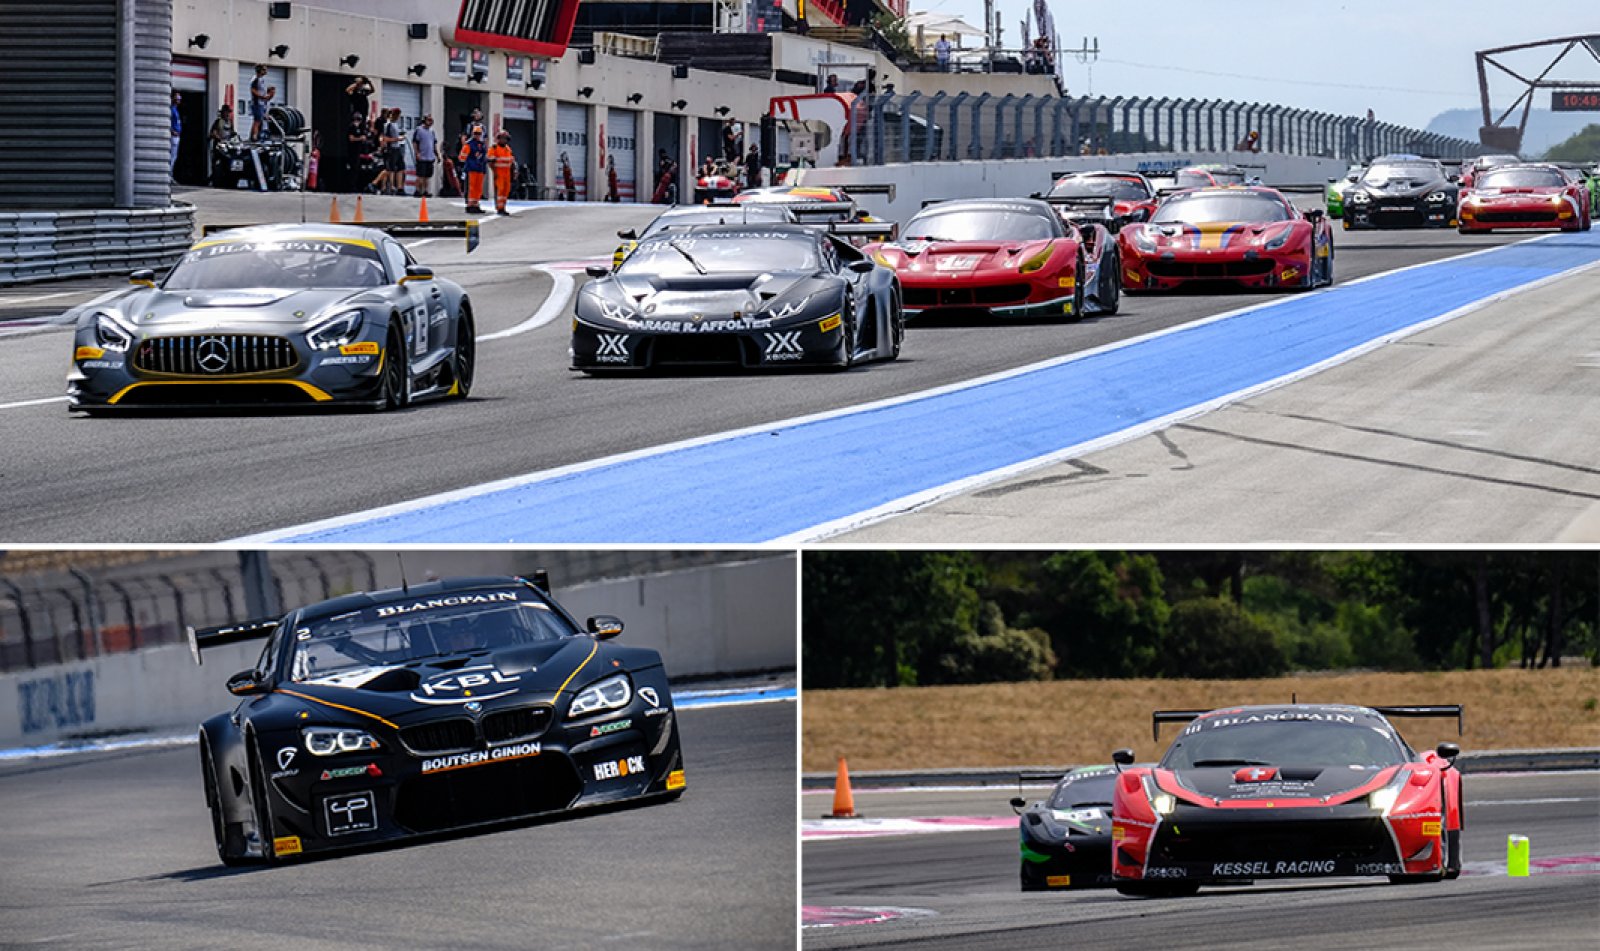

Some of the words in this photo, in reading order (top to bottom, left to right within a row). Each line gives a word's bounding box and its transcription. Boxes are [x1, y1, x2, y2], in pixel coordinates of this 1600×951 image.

[209, 242, 342, 256] BLAPAIN
[627, 319, 680, 332] GARAGE
[699, 318, 773, 333] AFFOLTER
[376, 591, 518, 617] BLANCPAIN
[421, 670, 522, 696] KBL
[1213, 713, 1356, 729] BLANCPAIN
[421, 750, 489, 772] BOUTSEN
[491, 741, 541, 760] GINION
[593, 755, 645, 781] HEROCK
[1212, 861, 1271, 875] KESSEL
[1275, 860, 1336, 874] RACING
